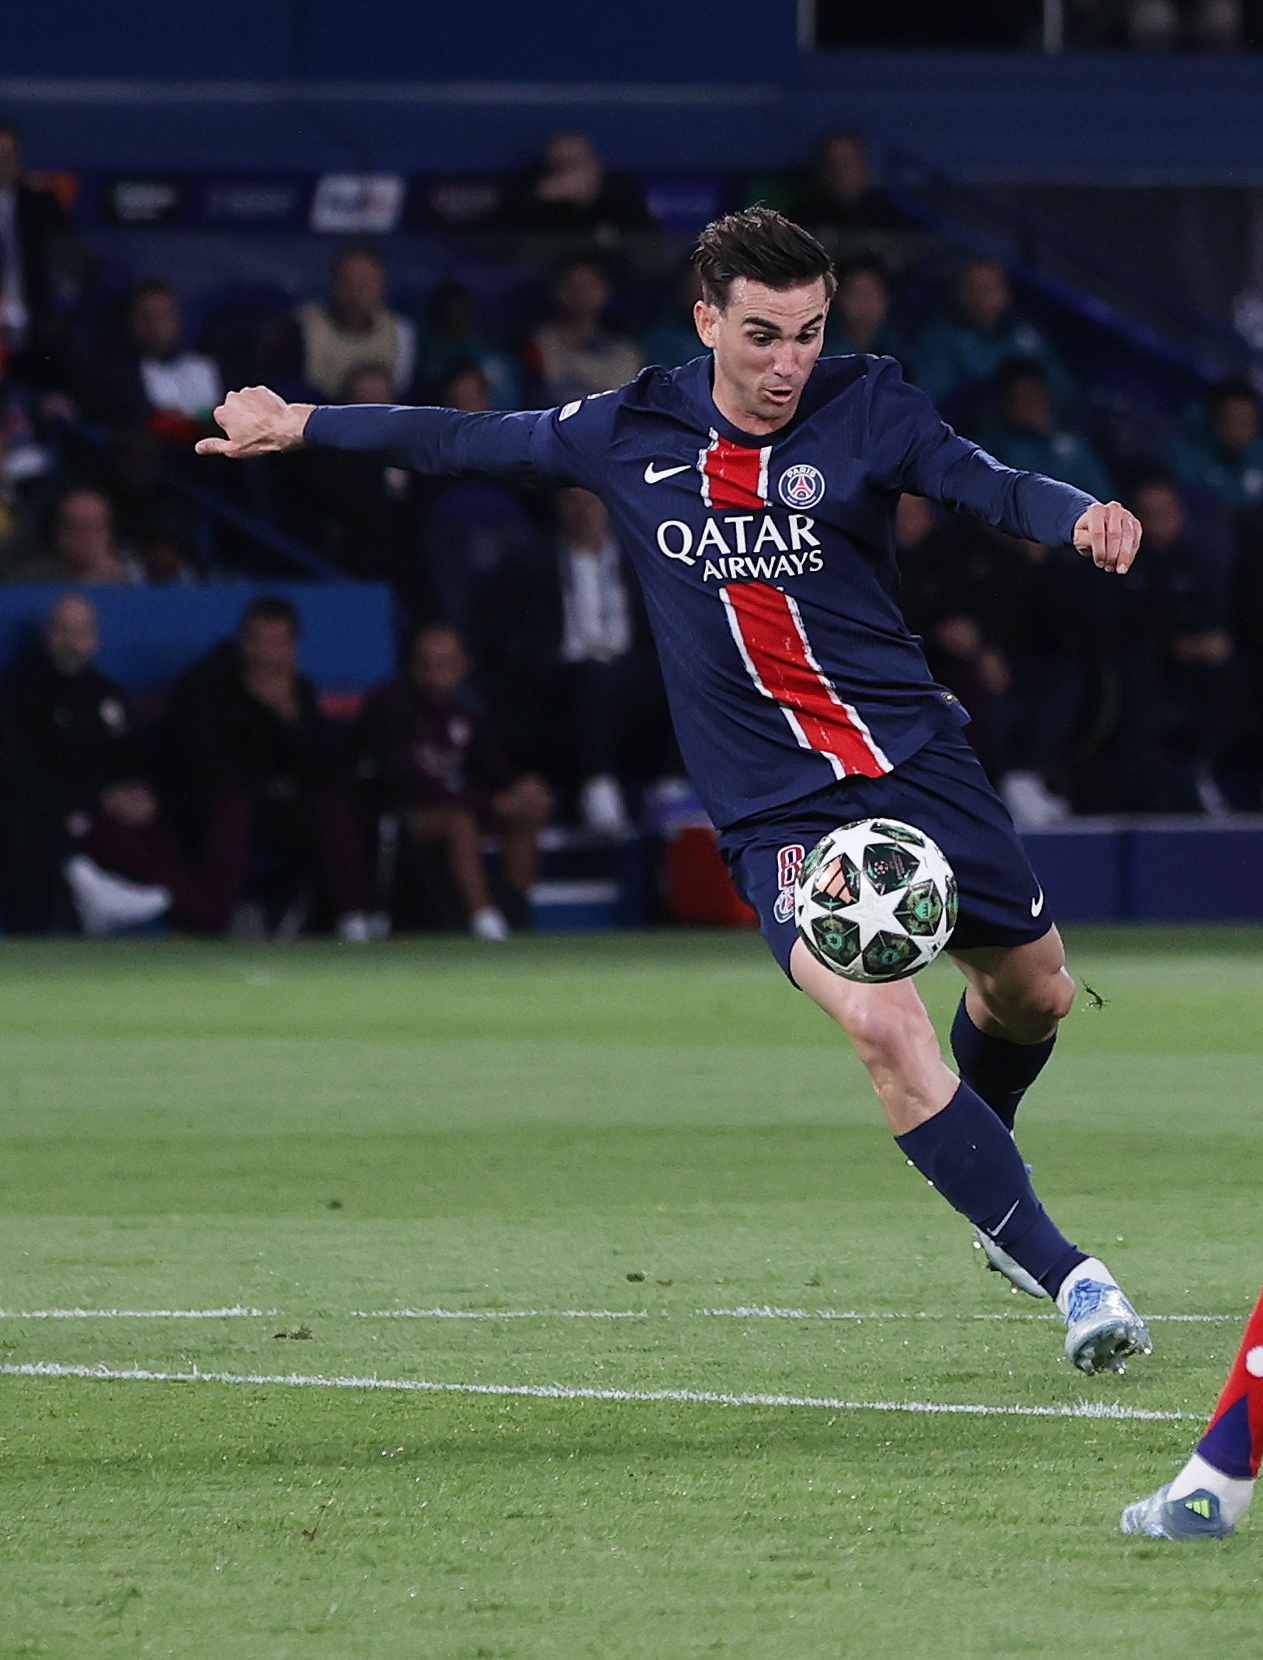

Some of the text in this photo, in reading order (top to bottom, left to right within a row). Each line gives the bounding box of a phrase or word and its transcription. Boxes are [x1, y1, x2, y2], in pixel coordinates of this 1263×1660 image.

[786, 466, 816, 478] PARIS
[657, 514, 821, 565] QATAR
[703, 549, 824, 582] AIRWAYS
[777, 844, 805, 890] 8
